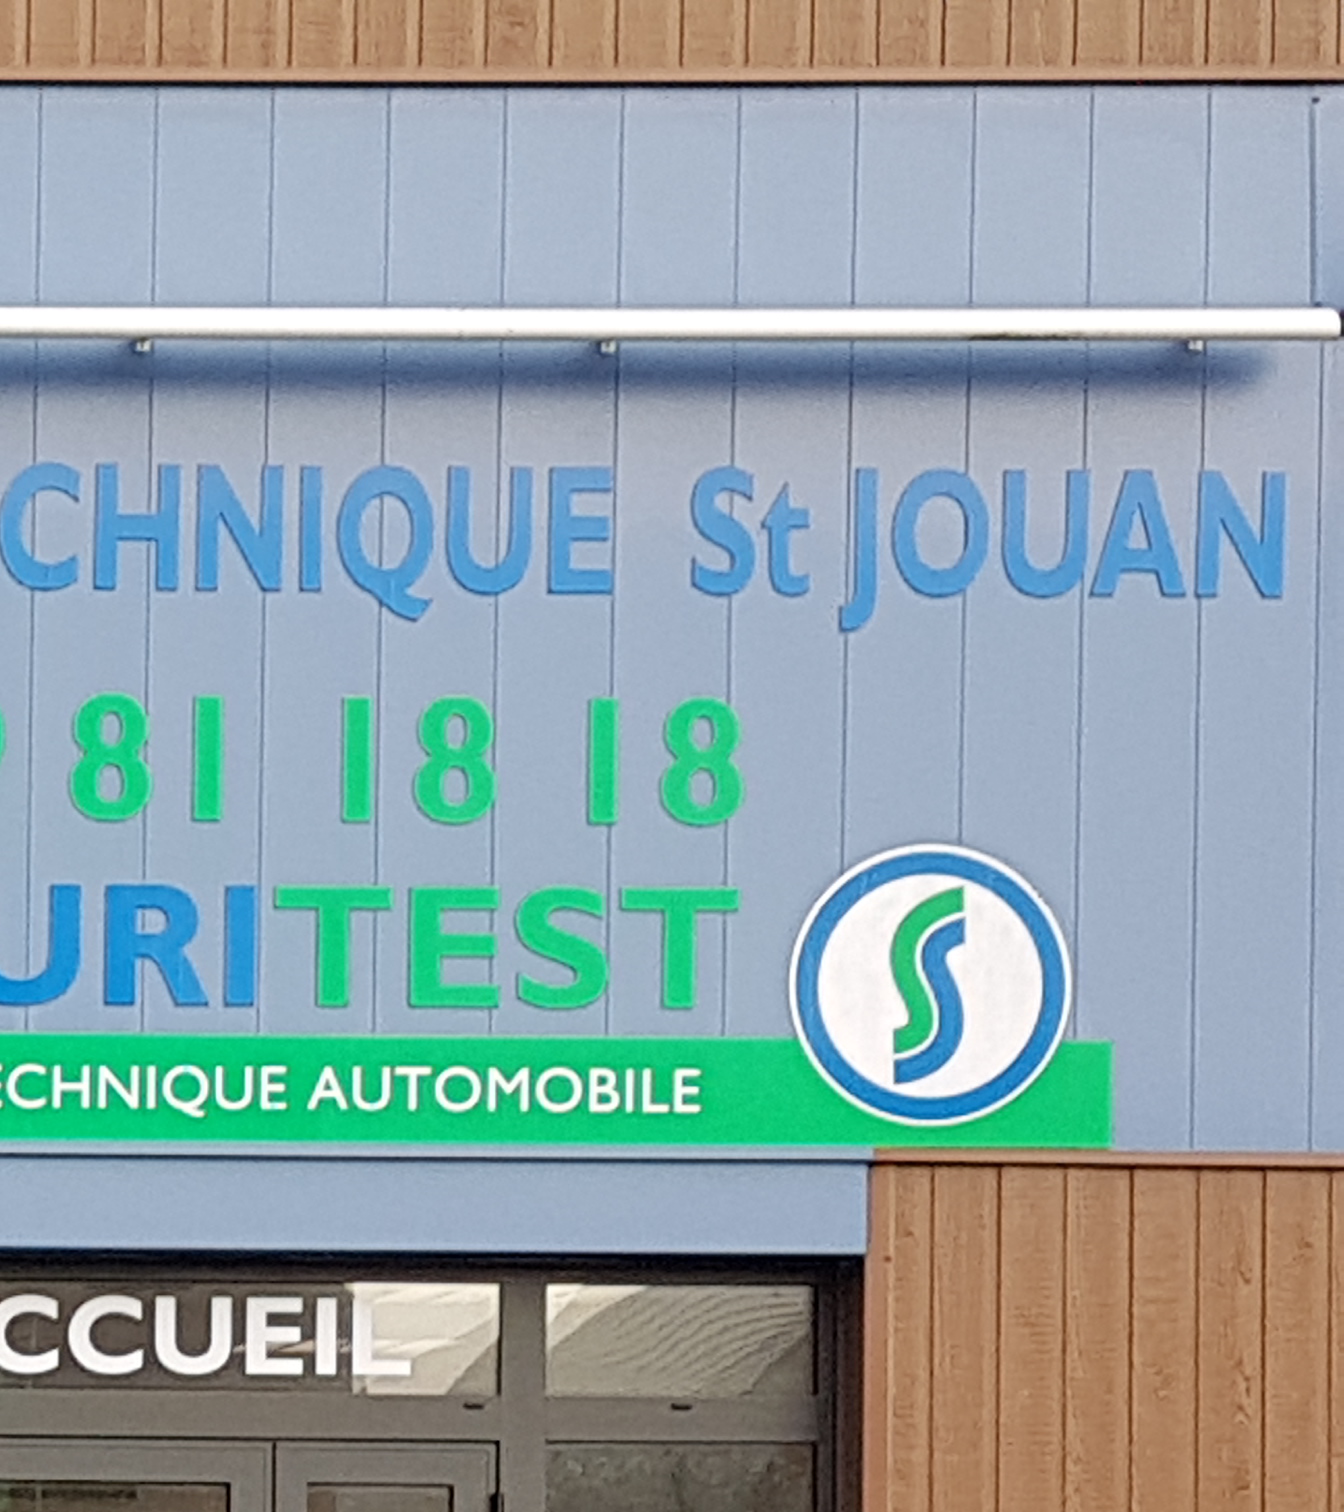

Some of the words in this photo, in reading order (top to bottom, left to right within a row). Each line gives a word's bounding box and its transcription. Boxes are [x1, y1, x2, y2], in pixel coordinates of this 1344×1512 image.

[688, 465, 810, 600] St
[838, 467, 1288, 634] JOUAN
[68, 692, 224, 823] 81
[341, 694, 498, 824] 18
[586, 696, 744, 826] 18
[306, 1065, 703, 1118] AUTOMOBILE
